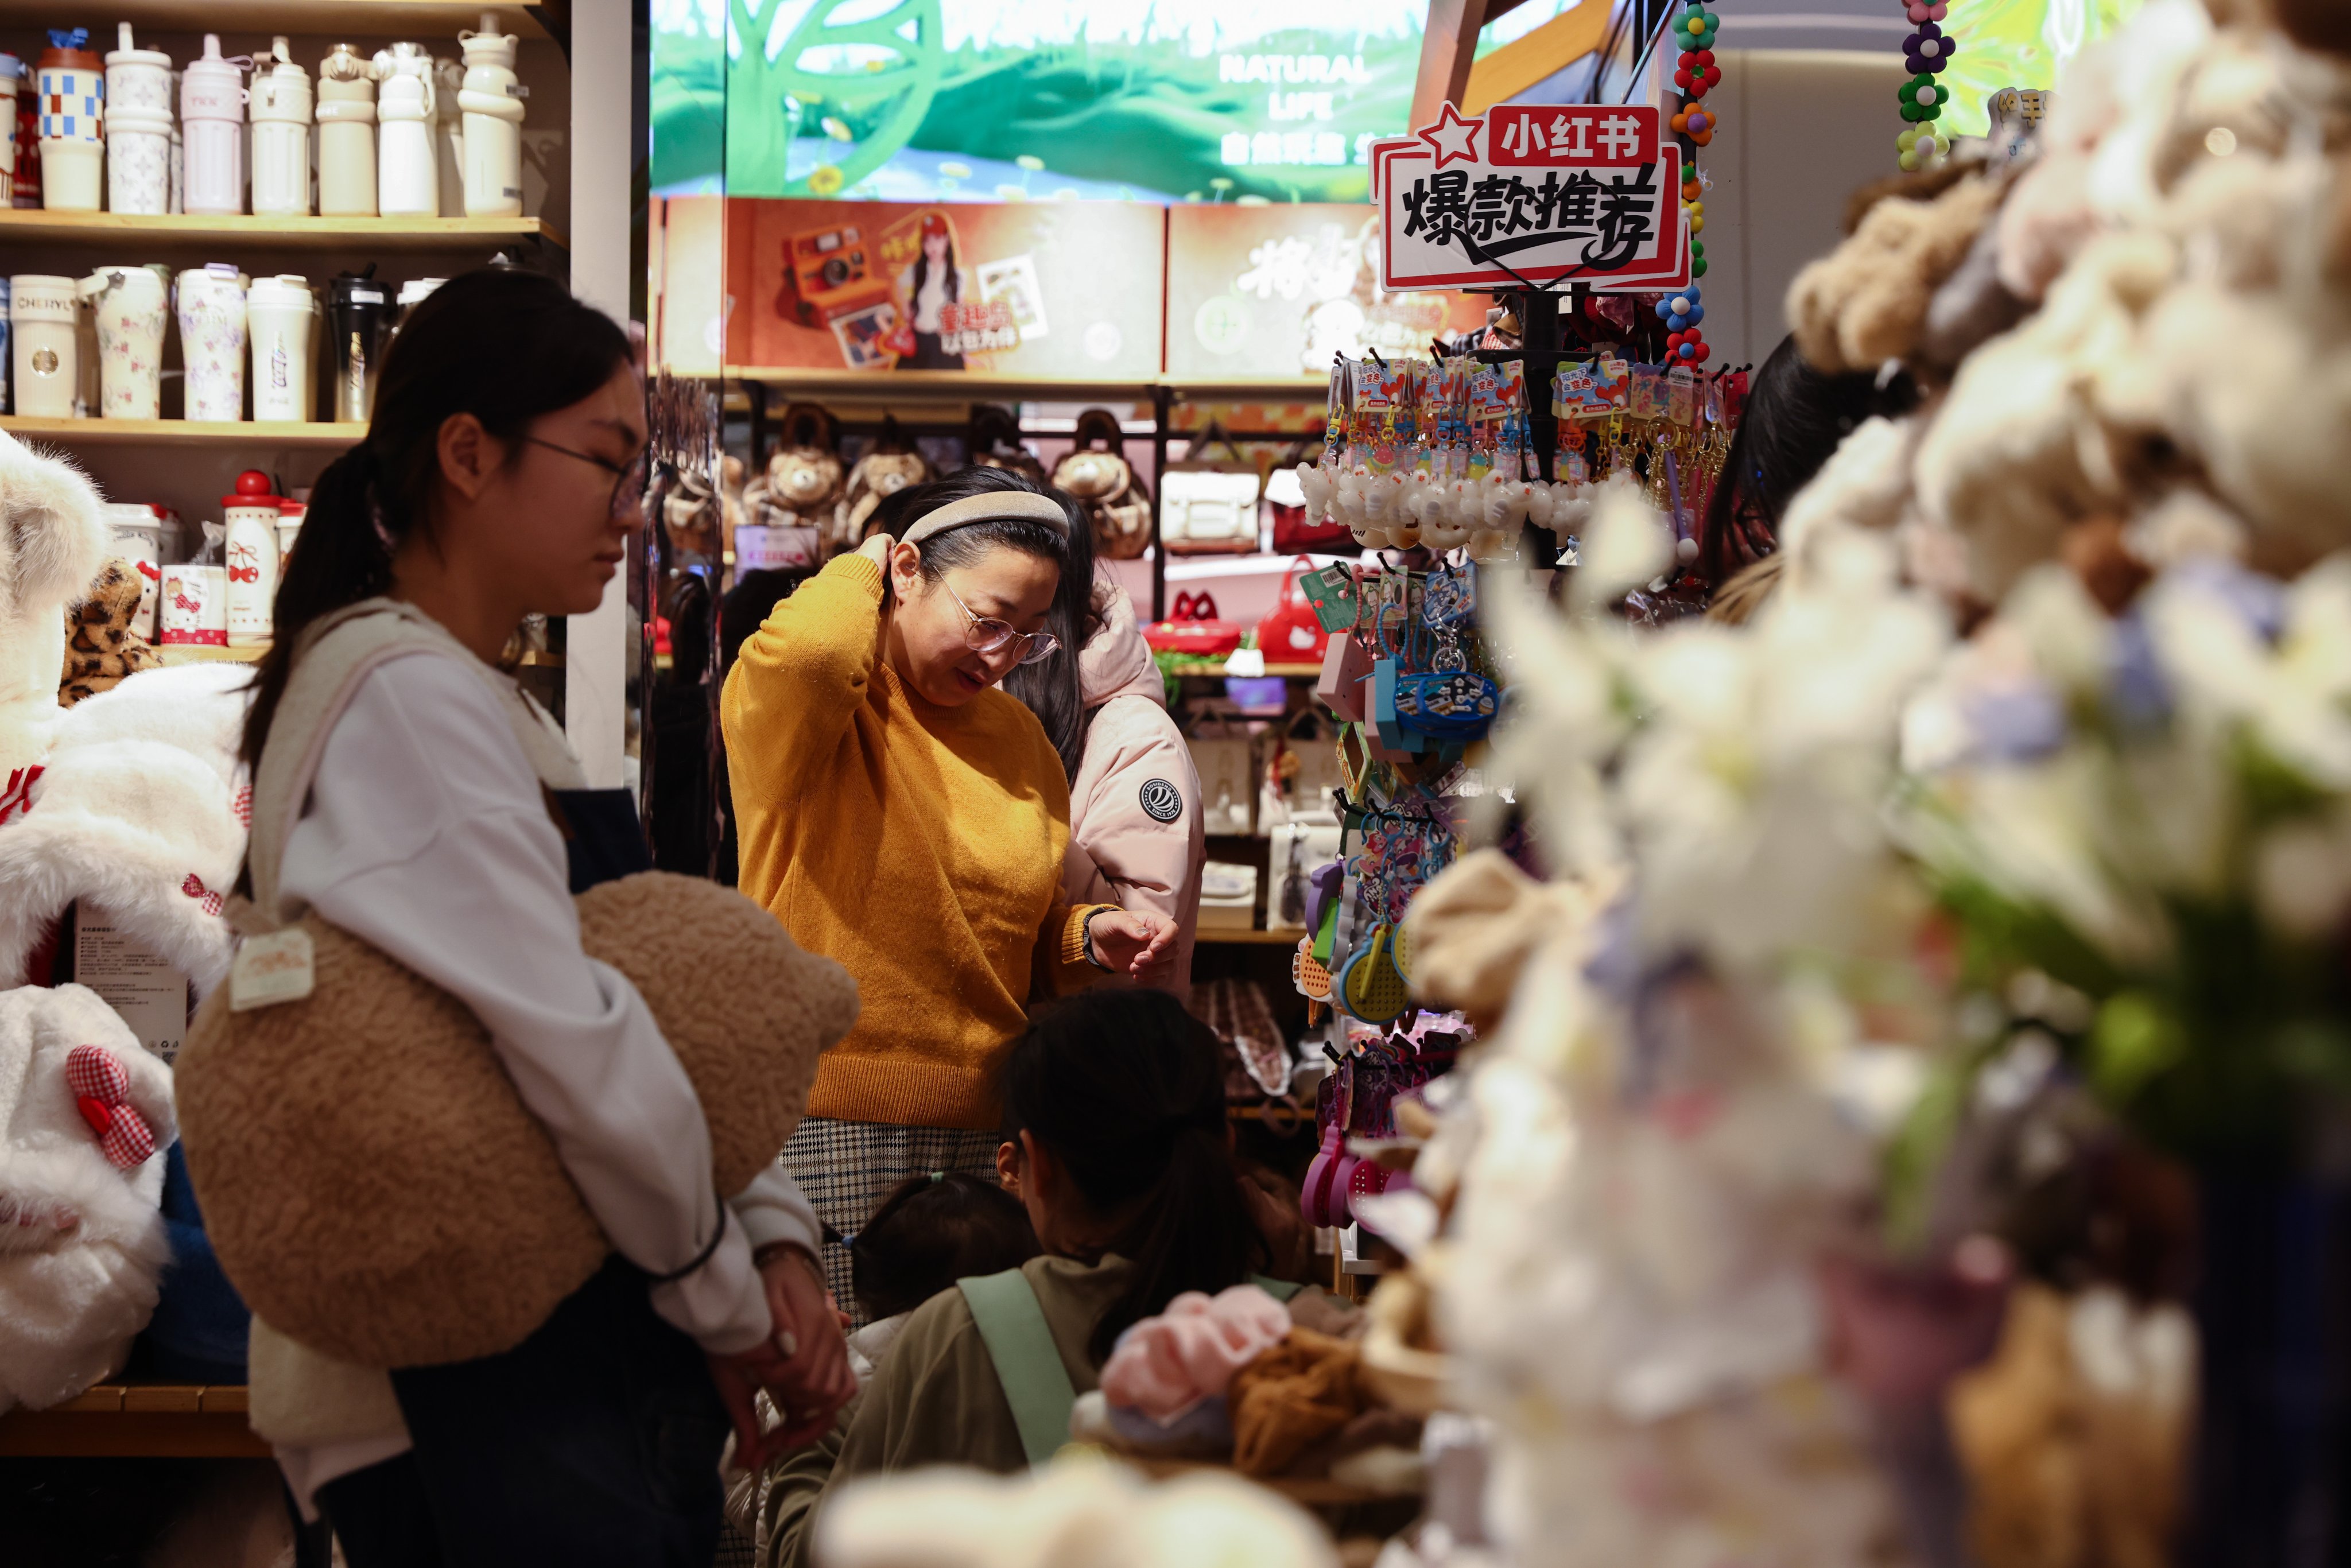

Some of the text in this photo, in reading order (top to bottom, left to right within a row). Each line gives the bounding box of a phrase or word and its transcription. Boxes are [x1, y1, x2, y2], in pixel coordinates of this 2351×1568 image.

[1220, 55, 1372, 83] NATURAL
[1268, 92, 1333, 121] LIFE
[1500, 114, 1641, 159] 小红书
[1403, 163, 1657, 271] 爆款推荐
[1562, 368, 1586, 382] 阳光下
[1147, 782, 1171, 791] BOSIDENG
[1151, 808, 1166, 817] SINCE
